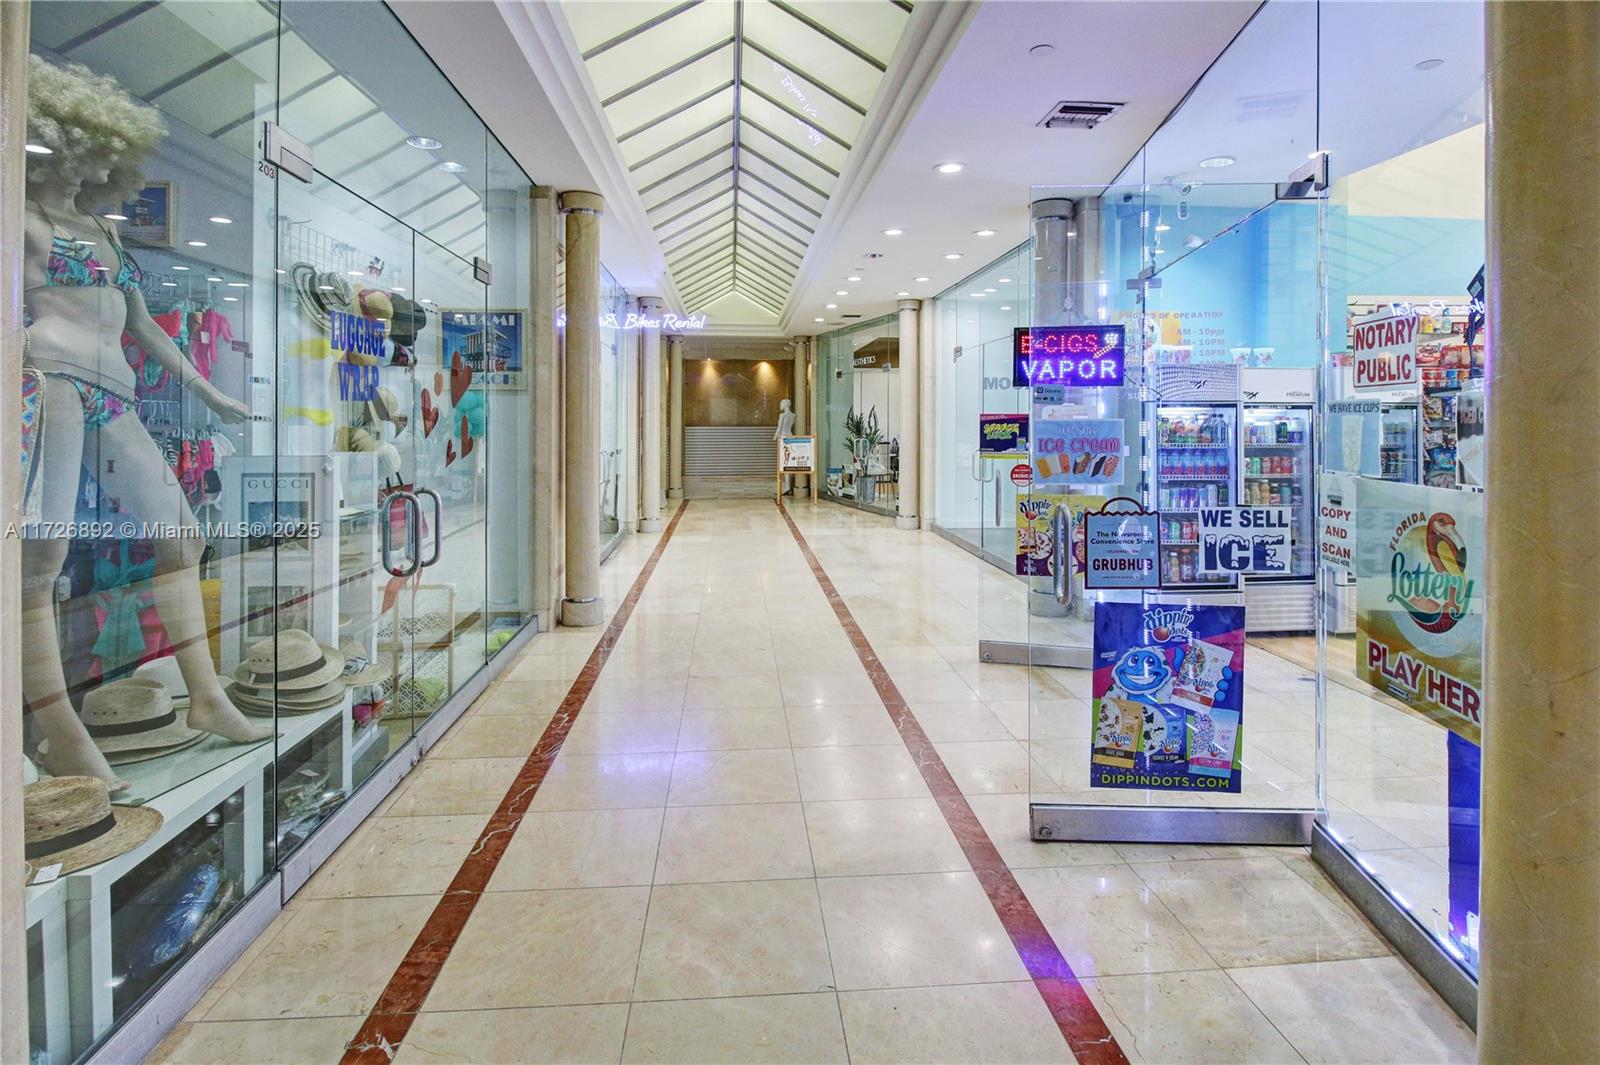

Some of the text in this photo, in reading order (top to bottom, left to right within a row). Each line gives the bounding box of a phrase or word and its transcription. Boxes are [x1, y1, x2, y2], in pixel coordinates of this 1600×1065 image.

[623, 313, 660, 329] Bikes
[662, 313, 706, 330] Rental
[1173, 311, 1224, 319] OPERATION
[329, 310, 385, 357] LUGGAGE
[1355, 316, 1416, 351] NOTARY
[1021, 334, 1098, 353] E-CIGS
[1021, 359, 1118, 379] VAPOR
[1357, 354, 1411, 383] PUBLIC
[338, 362, 380, 401] WRAP
[1362, 402, 1379, 412] CUPS
[247, 479, 309, 489] GUCCI
[1201, 510, 1288, 528] WE SELL
[1321, 506, 1351, 521] COPY
[1325, 525, 1348, 539] AND
[1389, 511, 1426, 552] FLORIDA
[1204, 534, 1285, 570] ICE
[1322, 542, 1351, 559] SCAN
[1093, 559, 1154, 571] GRUBHUB
[1387, 552, 1474, 620] Lottery
[1368, 639, 1423, 690] PLAY
[1101, 774, 1230, 788] DIPPINDOTS.COM
